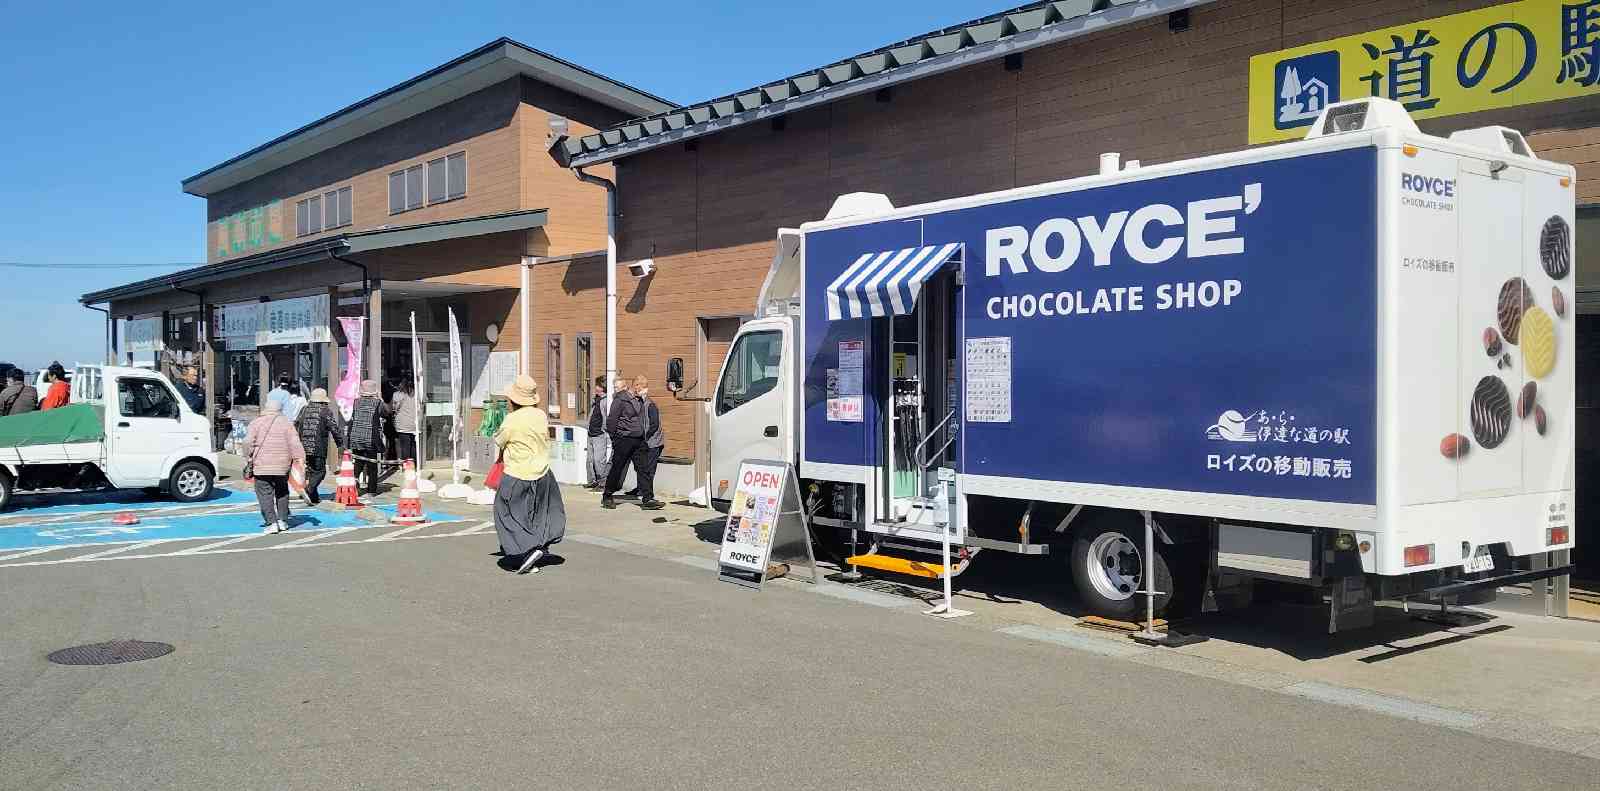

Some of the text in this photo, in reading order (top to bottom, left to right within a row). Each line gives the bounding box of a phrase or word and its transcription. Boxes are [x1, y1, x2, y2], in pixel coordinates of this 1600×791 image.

[1401, 172, 1457, 197] ROYCE'
[985, 182, 1262, 278] ROYCE'
[986, 279, 1242, 320] CHOCOLATE SHOP
[1257, 425, 1352, 446] 伊達な道の駅
[1207, 453, 1352, 479] ロイズの移動販売
[743, 470, 780, 489] OPEN
